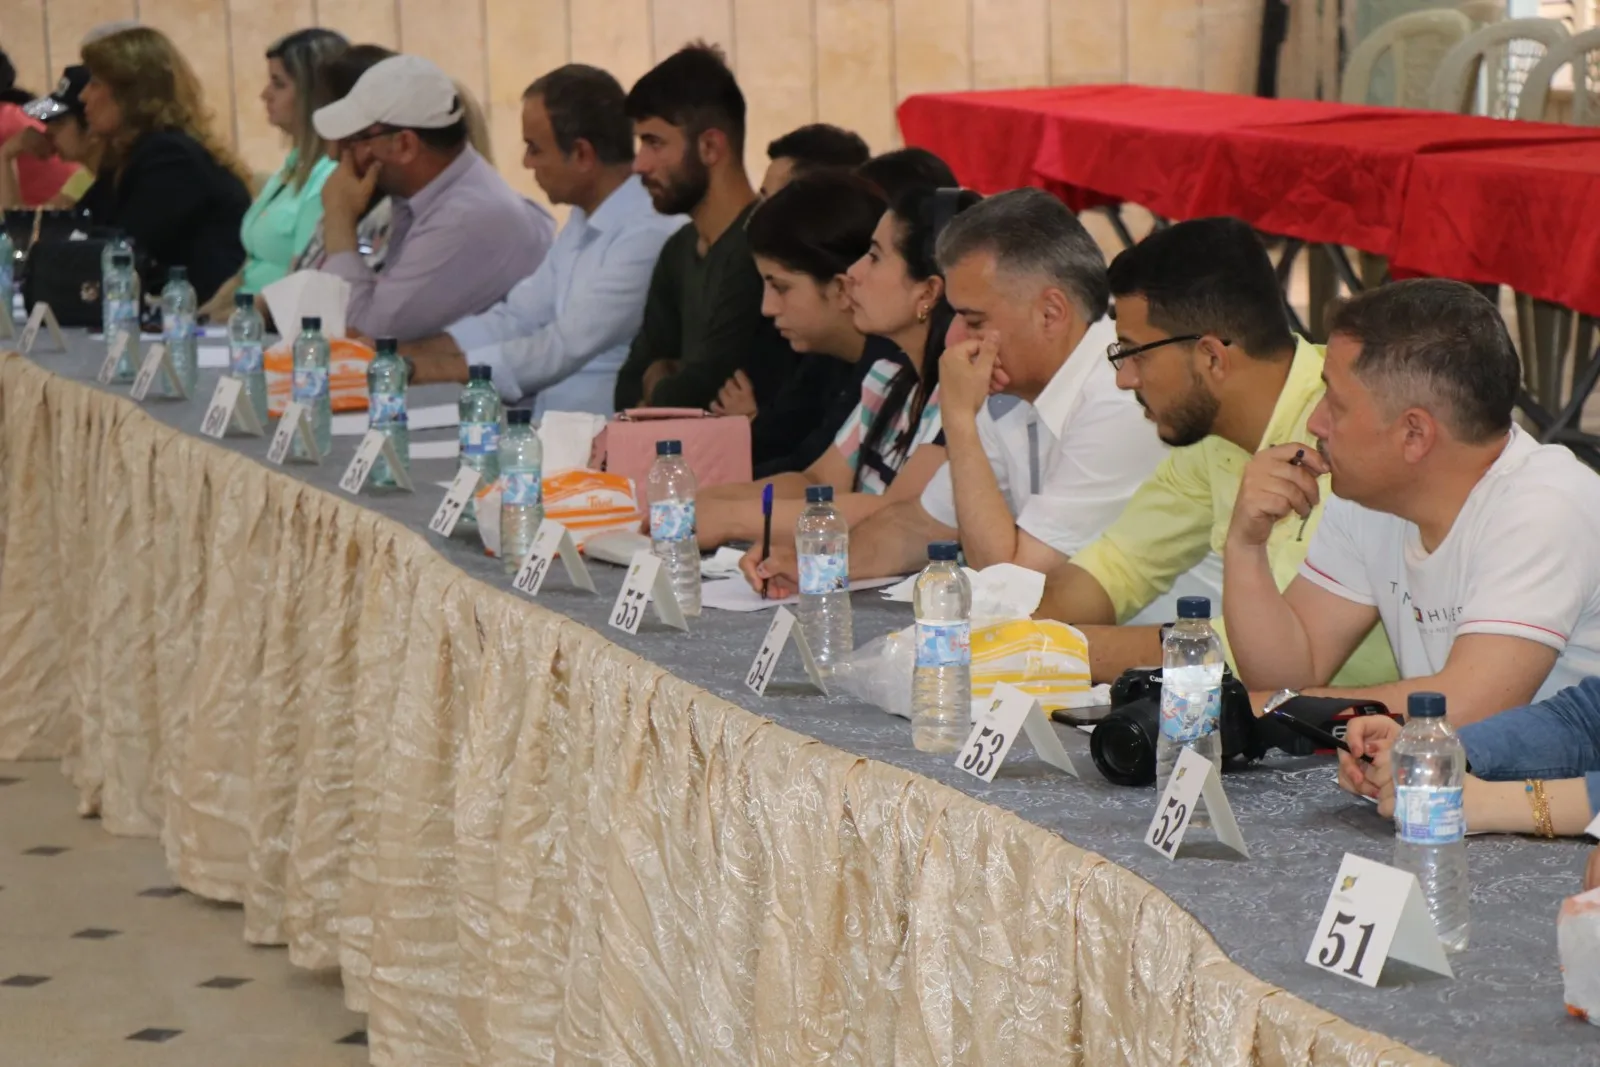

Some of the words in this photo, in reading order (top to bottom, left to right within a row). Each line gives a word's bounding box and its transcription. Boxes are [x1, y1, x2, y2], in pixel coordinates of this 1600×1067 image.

[345, 458, 368, 490] 58
[433, 498, 460, 533] 57
[518, 553, 547, 592] 56
[615, 588, 645, 630] 55
[748, 645, 775, 692] 54
[962, 725, 1005, 777] 53
[1152, 795, 1187, 853] 52
[1318, 909, 1376, 979] 51
